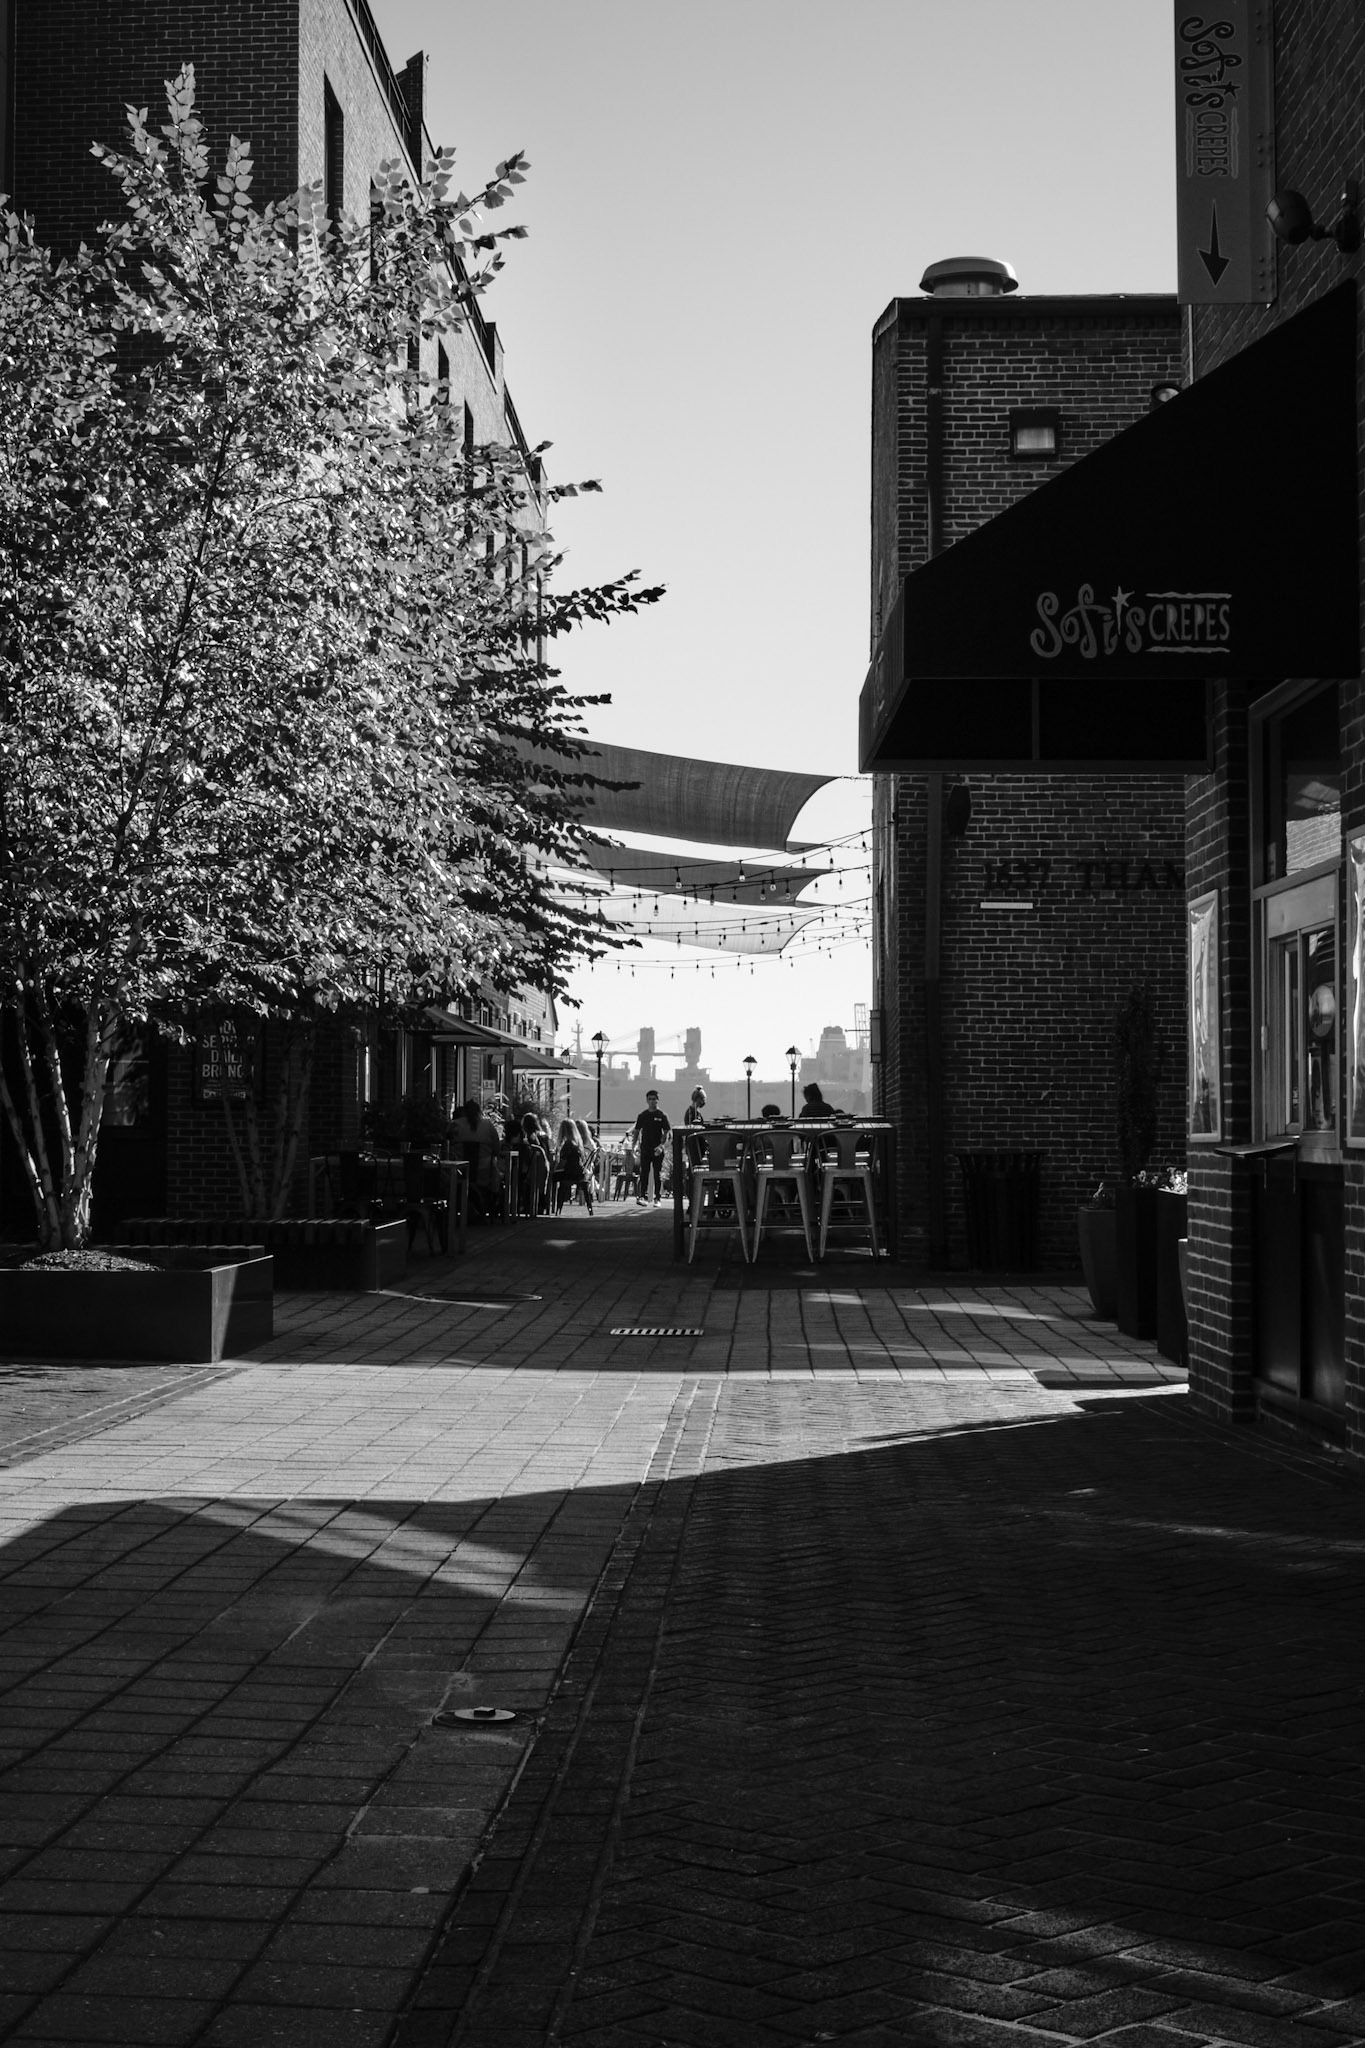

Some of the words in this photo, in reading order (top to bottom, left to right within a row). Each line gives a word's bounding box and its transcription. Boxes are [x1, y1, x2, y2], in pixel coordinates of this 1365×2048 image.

[1179, 16, 1242, 109] Sofi's
[1196, 111, 1228, 177] CREPES
[1029, 582, 1146, 659] Sofi's
[1148, 603, 1231, 642] CREPES
[202, 1064, 255, 1078] BRNC
